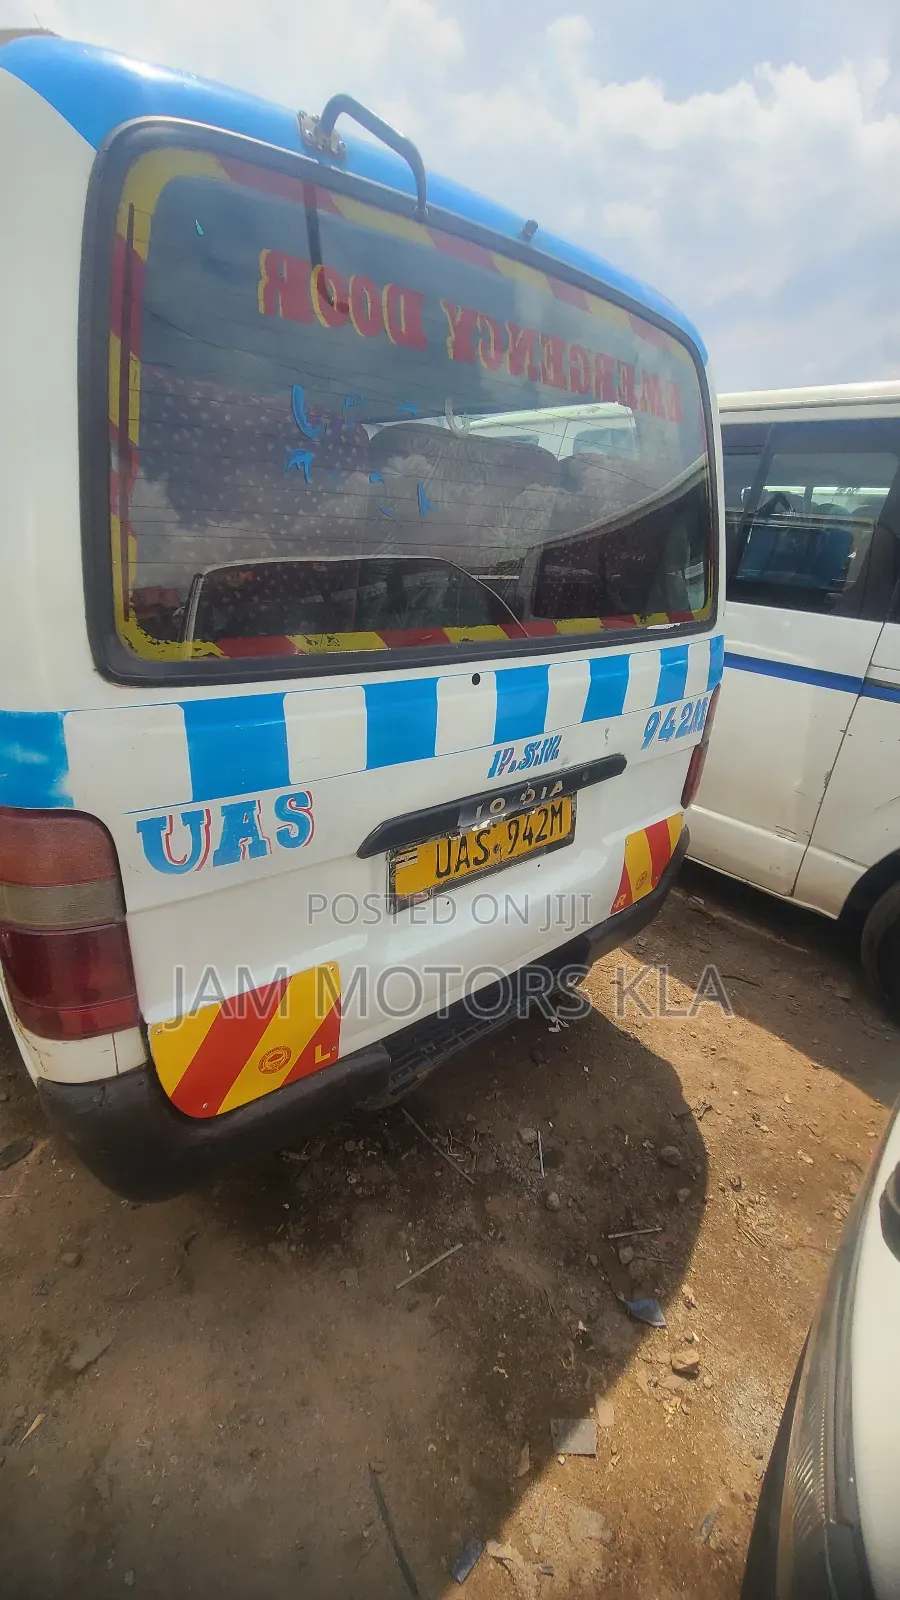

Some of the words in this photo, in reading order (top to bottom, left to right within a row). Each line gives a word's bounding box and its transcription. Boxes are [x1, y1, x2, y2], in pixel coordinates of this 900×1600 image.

[640, 696, 709, 750] 942M
[136, 790, 315, 875] UAS
[434, 828, 491, 879] UAS
[507, 800, 563, 855] 942M
[615, 893, 627, 909] R
[315, 1045, 331, 1064] L
